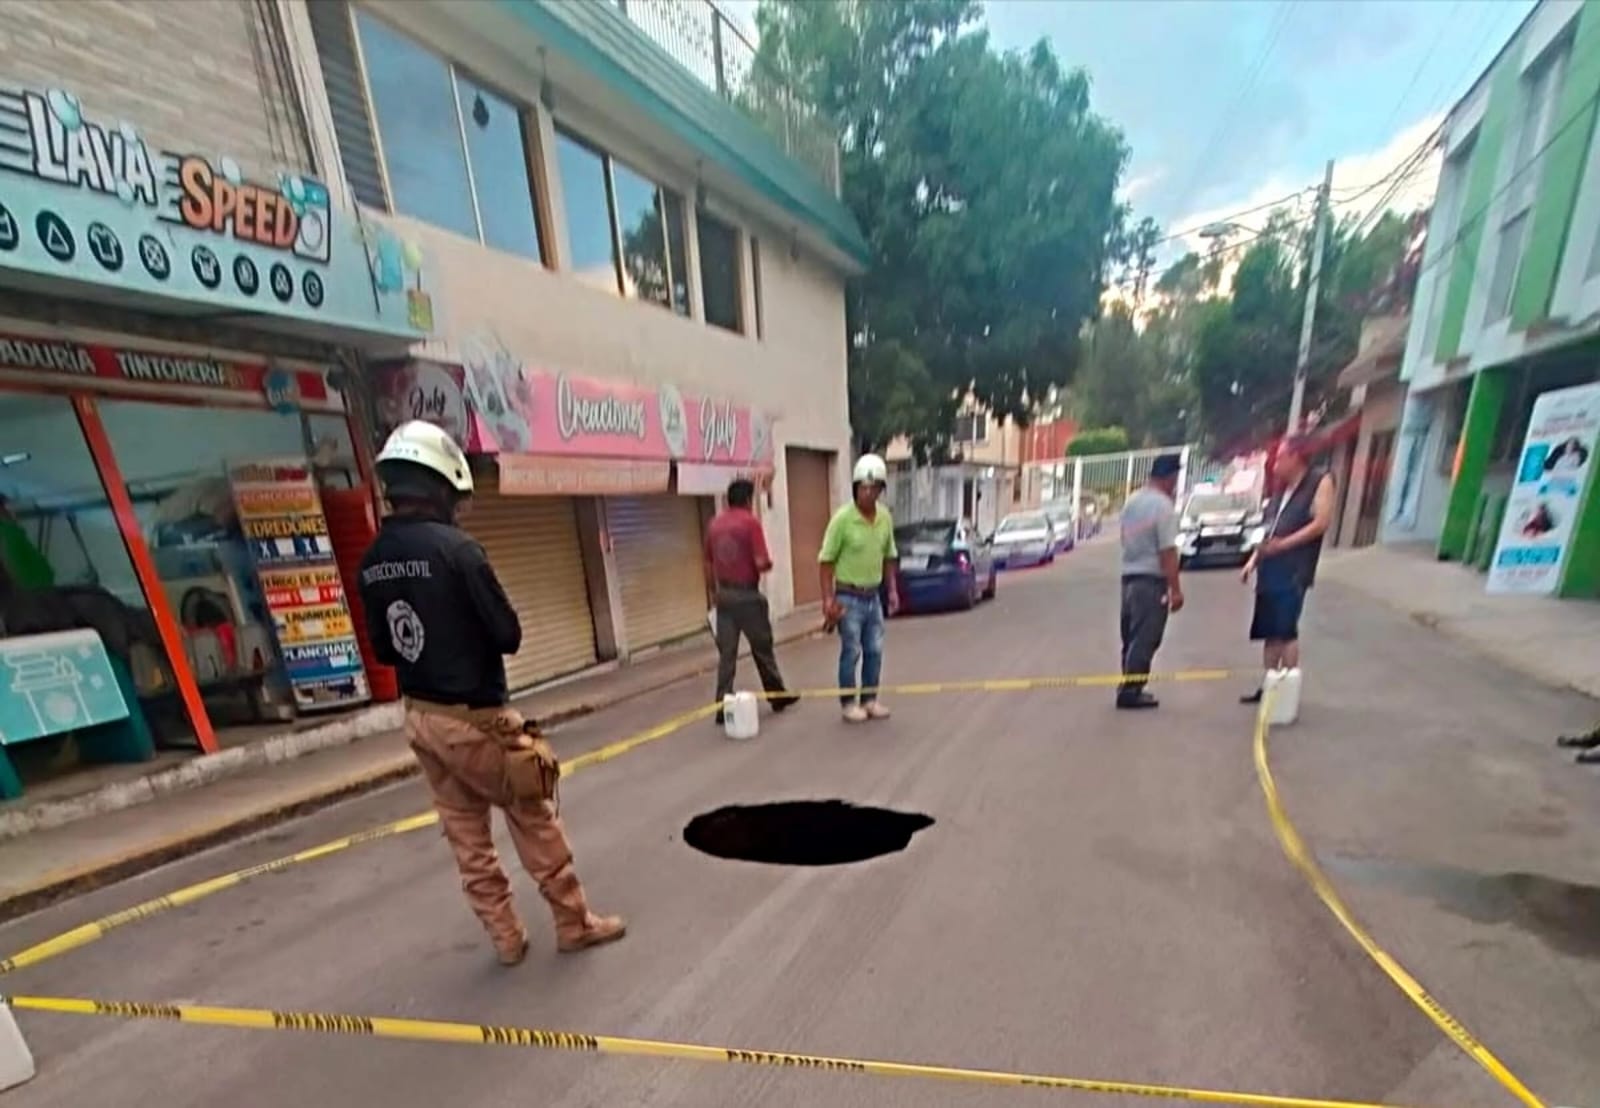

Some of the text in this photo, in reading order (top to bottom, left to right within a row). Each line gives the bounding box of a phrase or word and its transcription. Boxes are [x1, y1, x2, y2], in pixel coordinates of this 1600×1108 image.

[24, 90, 298, 248] LAVA SPEED
[557, 371, 645, 438] Creaciones
[700, 395, 737, 461] July
[407, 560, 432, 577] CIVIL
